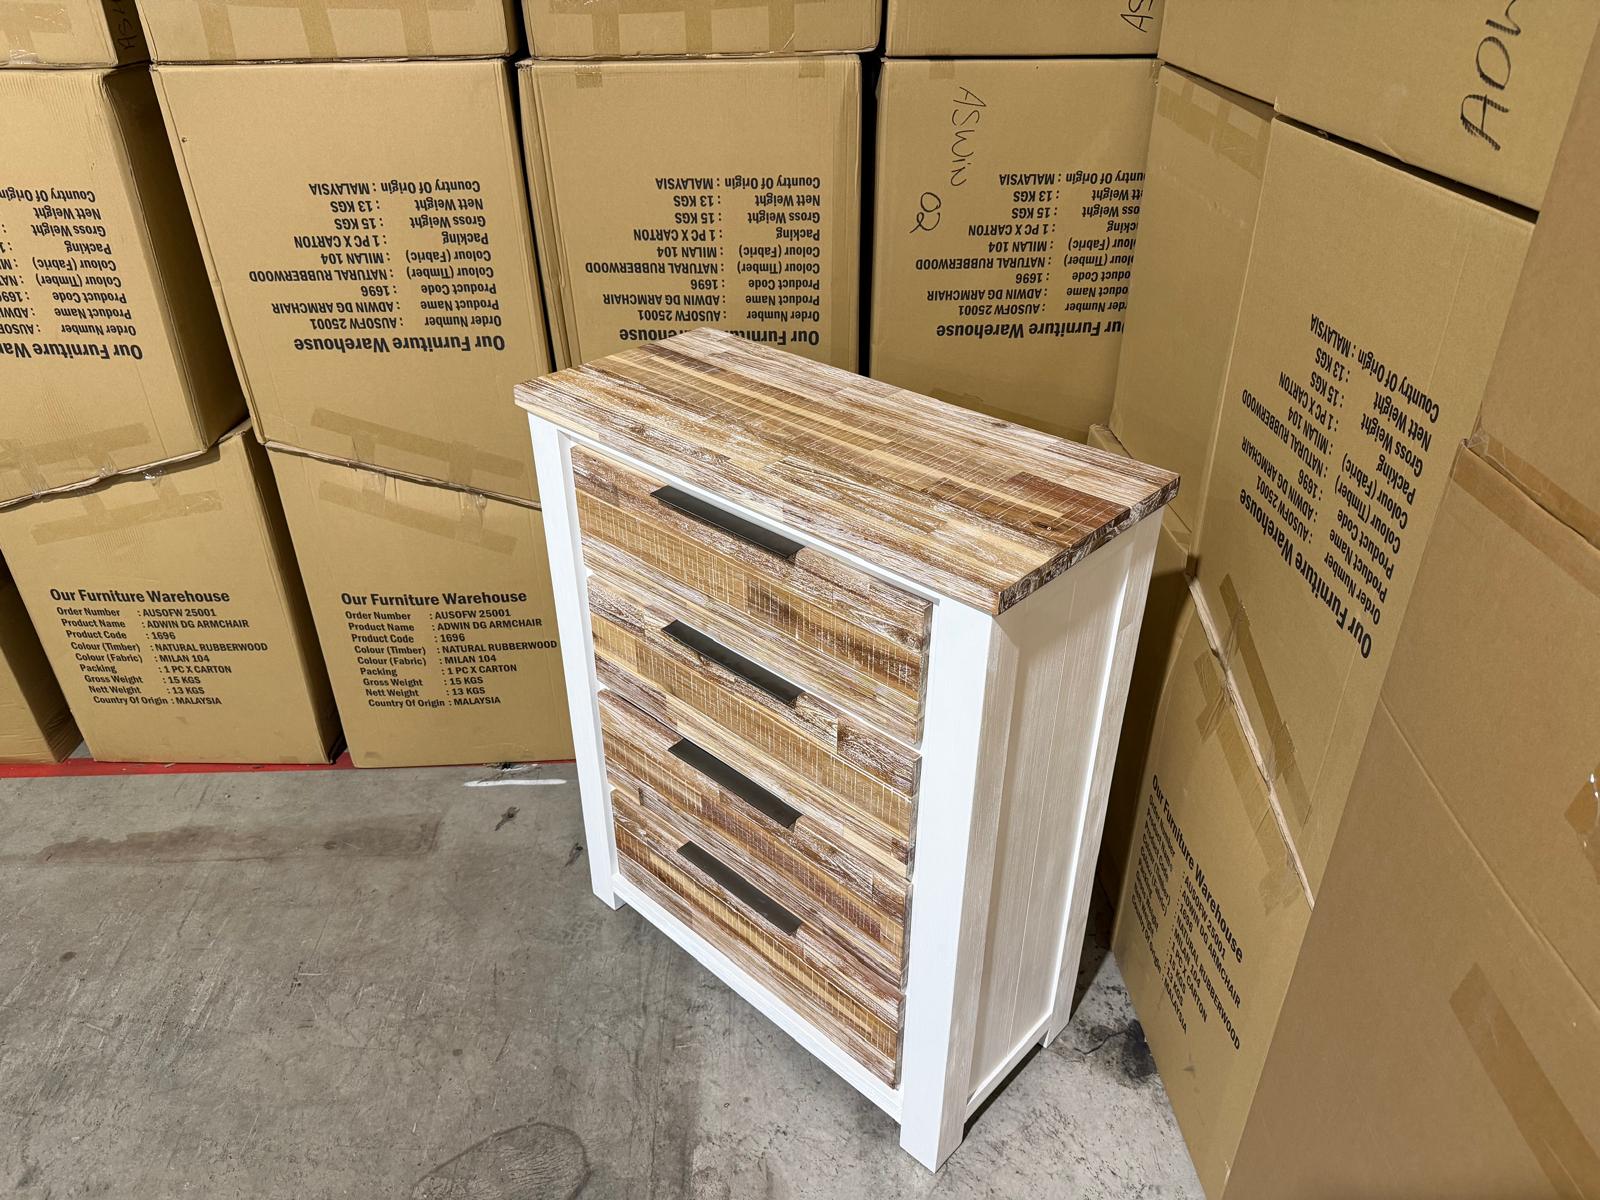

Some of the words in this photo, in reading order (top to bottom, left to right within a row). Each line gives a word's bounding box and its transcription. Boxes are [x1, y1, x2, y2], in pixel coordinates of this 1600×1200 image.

[654, 177, 714, 190] MALAYSIA
[724, 174, 758, 190] Origin
[760, 177, 774, 190] Of
[776, 174, 821, 189] Country
[998, 173, 1055, 186] MALAYSIA
[1065, 170, 1098, 185] Origin
[1099, 172, 1113, 185] Of
[308, 182, 370, 196] MALAYSIA
[380, 179, 416, 194] Origin
[418, 181, 432, 194] Of
[434, 178, 481, 193] Country
[1012, 190, 1036, 203] KGS
[1038, 190, 1053, 202] 13
[329, 200, 355, 213] KGS
[357, 200, 373, 213] 13
[413, 196, 457, 211] Weight
[457, 198, 484, 210] Nett
[333, 217, 359, 230] KGS
[360, 217, 377, 230] 15
[408, 214, 452, 229] Weight
[452, 215, 486, 227] Gross
[30, 221, 73, 237] Weight
[72, 225, 106, 237] Gross
[293, 235, 342, 248] CARTON
[342, 235, 352, 248] X
[353, 234, 370, 248] PC
[371, 234, 380, 247] 1
[441, 230, 489, 246] Packing
[988, 241, 1009, 253] 104
[1011, 240, 1047, 253] MILAN
[320, 252, 343, 265] 104
[345, 252, 384, 264] MILAN
[405, 248, 451, 263] (Fabric)
[453, 249, 491, 262] Colour
[585, 262, 666, 274] RUBBERWOOD
[667, 262, 718, 274] NATURAL
[736, 260, 782, 275] (Timber)
[784, 262, 820, 274] Colour
[915, 257, 994, 270] RUBBERWOOD
[995, 256, 1046, 269] NATURAL
[248, 269, 333, 282] RUBBERWOOD
[333, 268, 388, 281] NATURAL
[406, 264, 454, 280] (Timber)
[456, 266, 494, 278] Colour
[360, 285, 390, 297] 1696
[420, 284, 450, 296] Code
[451, 283, 497, 295] Product
[51, 291, 81, 303] Code
[81, 292, 127, 304] Product
[602, 293, 663, 305] ARMCHAIR
[664, 294, 681, 306] DG
[683, 294, 720, 306] ADWIN
[745, 295, 776, 306] Name
[777, 295, 820, 306] Product
[271, 302, 333, 314] ARMCHAIR
[335, 301, 354, 313] DG
[354, 301, 394, 313] ADWIN
[420, 300, 453, 311] Name
[454, 299, 499, 311] Product
[958, 304, 993, 316] 25001
[993, 303, 1041, 315] AUSOFW
[424, 315, 469, 328] Number
[470, 315, 502, 327] Order
[637, 309, 673, 321] 25001
[674, 309, 721, 322] AUSOFW
[746, 310, 788, 322] Number
[789, 310, 820, 322] Order
[309, 317, 347, 330] 25001
[349, 317, 397, 329] AUSOFW
[1028, 321, 1101, 337] Furniture
[61, 324, 105, 336] Number
[105, 324, 136, 336] Order
[936, 323, 1024, 339] Warehouse
[391, 336, 471, 352] Furniture
[474, 335, 505, 351] Our
[790, 330, 819, 346] Our
[31, 343, 110, 360] Furniture
[293, 337, 390, 353] Warehouse
[112, 344, 143, 360] Our
[1278, 371, 1309, 409] CARTON
[1309, 370, 1328, 397] KGS
[1326, 385, 1340, 407] 15
[1307, 396, 1316, 416] X
[1314, 403, 1327, 426] PC
[1327, 413, 1334, 430] 1
[1360, 412, 1393, 455] Weight
[1394, 440, 1423, 478] Gross
[1297, 468, 1318, 499] 1696
[1375, 453, 1416, 506] Packing
[1256, 474, 1279, 509] 25001
[1276, 499, 1310, 542] AUSOFW
[1336, 509, 1359, 541] Code
[1239, 488, 1294, 567] Warehouse
[1358, 530, 1394, 580] Product
[1323, 551, 1357, 598] Number
[49, 588, 76, 601] Our
[77, 588, 145, 603] Furniture
[145, 590, 230, 603] Warehouse
[1294, 551, 1348, 630] Furniture
[340, 592, 367, 605] Our
[370, 593, 440, 606] Furniture
[441, 591, 527, 605] Warehouse
[56, 606, 82, 616] Order
[83, 607, 120, 616] Number
[142, 608, 183, 617] AUSOFW
[184, 608, 217, 617] 25001
[1355, 588, 1381, 625] Order
[60, 618, 99, 628] Product
[98, 618, 126, 628] Name
[147, 620, 179, 629] ADWIN
[179, 619, 196, 628] DG
[196, 619, 250, 628] ARMCHAIR
[347, 622, 386, 631] Product
[386, 622, 415, 631] Name
[437, 621, 471, 631] ADWIN
[472, 621, 487, 629] DG
[488, 618, 542, 629] ARMCHAIR
[65, 629, 103, 639] Product
[102, 630, 127, 639] Code
[151, 631, 176, 640] 1696
[1347, 616, 1372, 659] Our
[70, 641, 100, 650] Colour
[101, 642, 141, 653] (Timber)
[154, 643, 199, 652] NATURAL
[198, 642, 268, 652] RUBBERWOOD
[74, 652, 105, 661] Colour
[106, 653, 143, 664] (Fabric)
[158, 654, 190, 663] MILAN
[191, 654, 210, 663] 104
[357, 656, 387, 665] Colour
[388, 656, 427, 666] (Fabric)
[444, 655, 476, 664] MILAN
[478, 654, 497, 663] 104
[79, 663, 118, 674] Packing
[163, 665, 170, 673] 1
[170, 665, 185, 673] PC
[185, 665, 193, 673] X
[193, 665, 232, 673] CARTON
[84, 674, 111, 683] Gross
[110, 675, 143, 685] Weight
[167, 675, 181, 684] 15
[180, 675, 201, 684] KGS
[88, 685, 109, 693] Nett
[108, 685, 142, 695] Weight
[171, 686, 184, 694] 13
[184, 686, 205, 694] KGS
[92, 695, 128, 705] Country
[128, 696, 140, 704] Of
[140, 696, 168, 706] Origin
[175, 696, 222, 705] MALAYSIA
